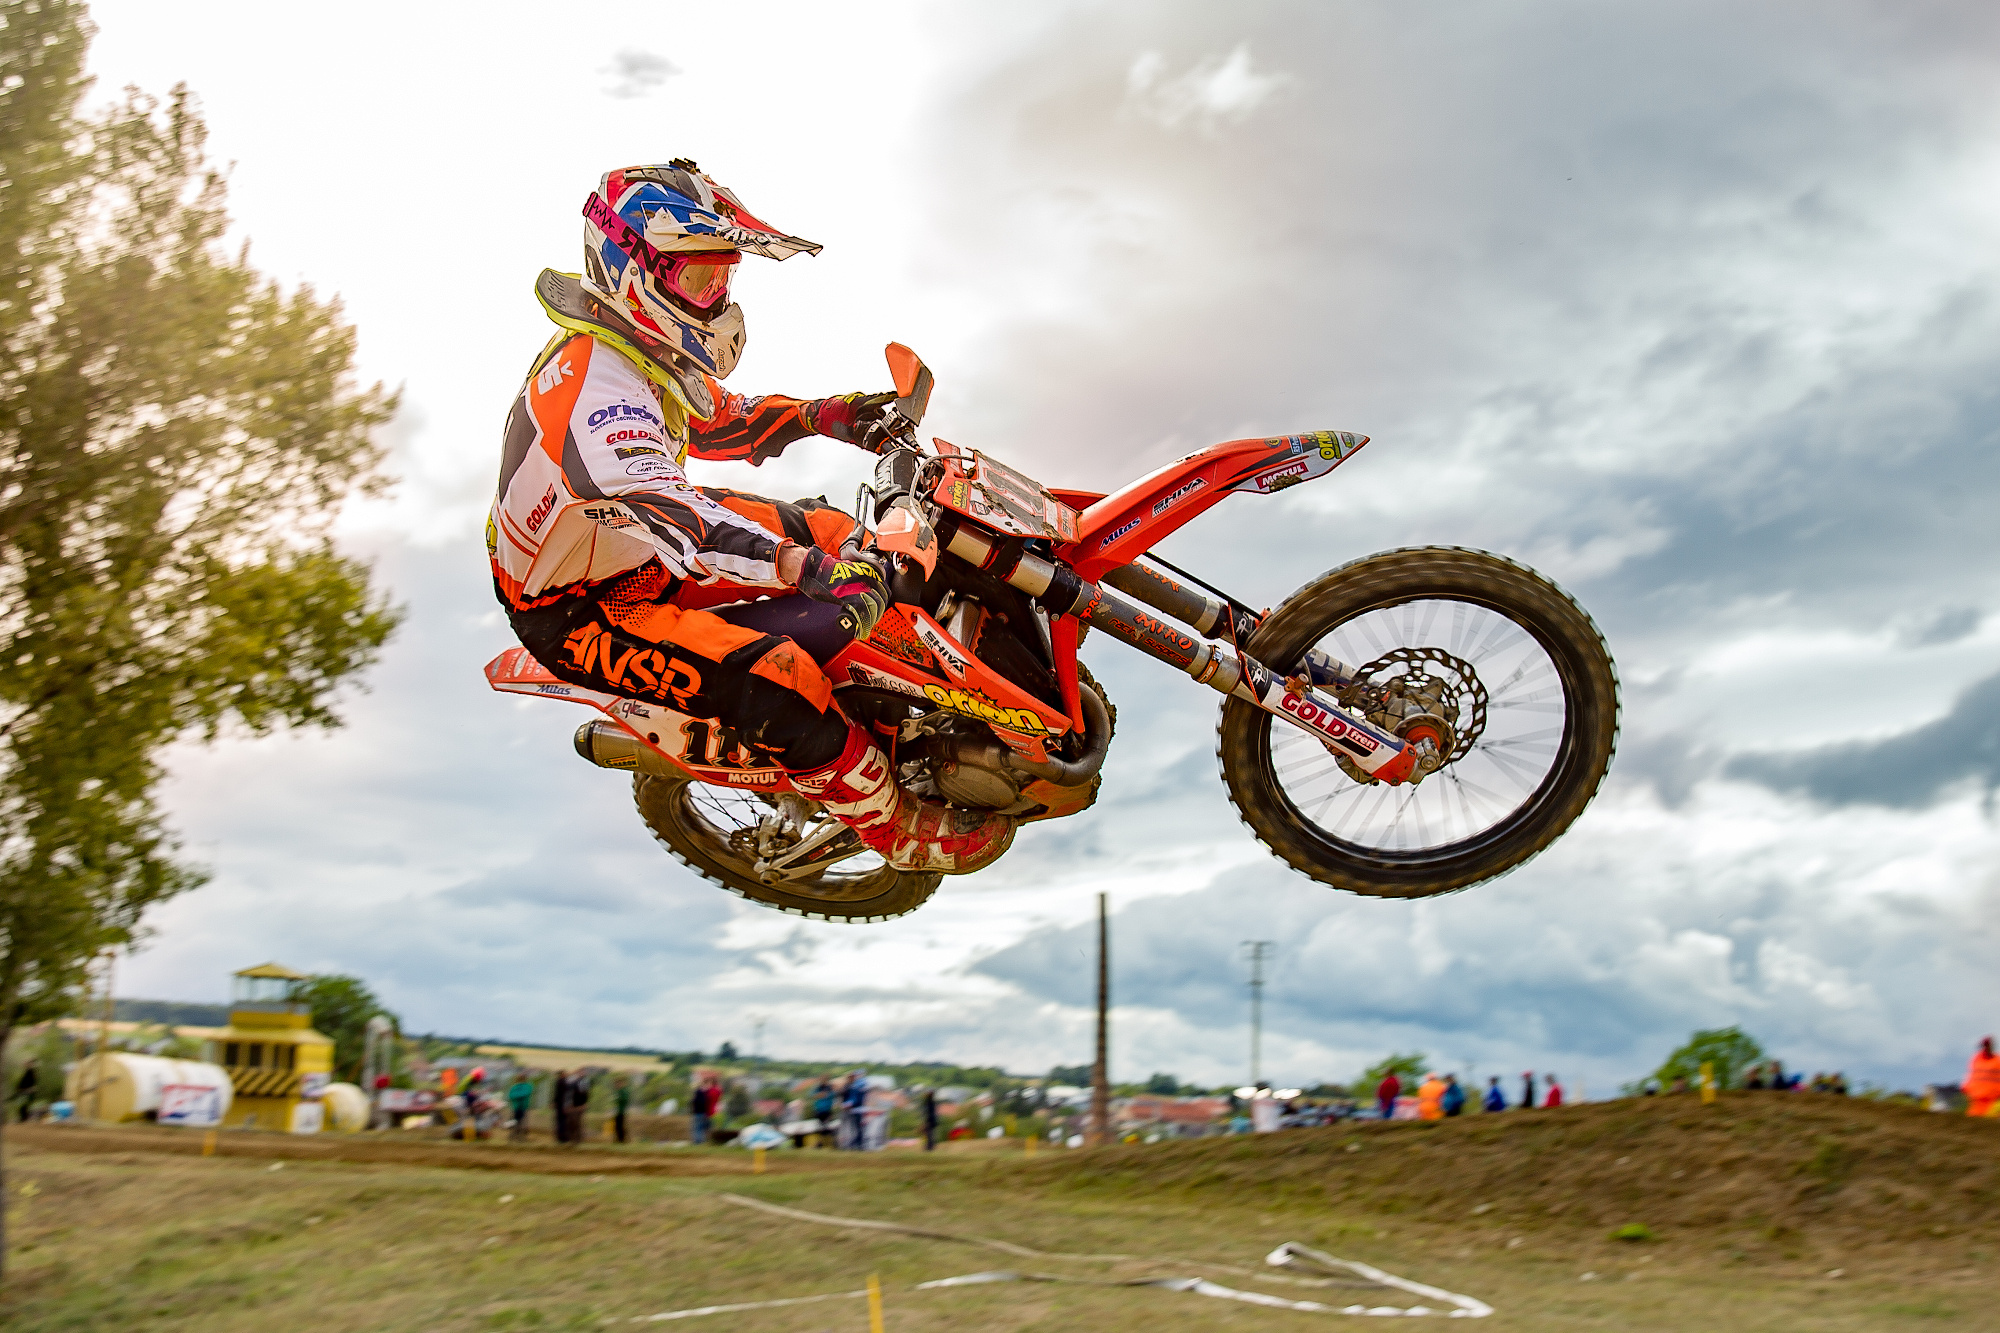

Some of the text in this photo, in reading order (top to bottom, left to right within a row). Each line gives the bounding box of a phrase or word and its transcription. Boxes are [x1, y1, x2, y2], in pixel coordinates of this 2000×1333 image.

[606, 429, 649, 445] GOLD
[526, 500, 551, 532] GOLD
[1100, 517, 1142, 550] Mitas
[1134, 612, 1193, 650] MIRO
[925, 630, 964, 675] SHIVA
[536, 684, 573, 696] Mitas
[1281, 692, 1378, 750] GOLD fren
[727, 772, 778, 784] MOTUL
